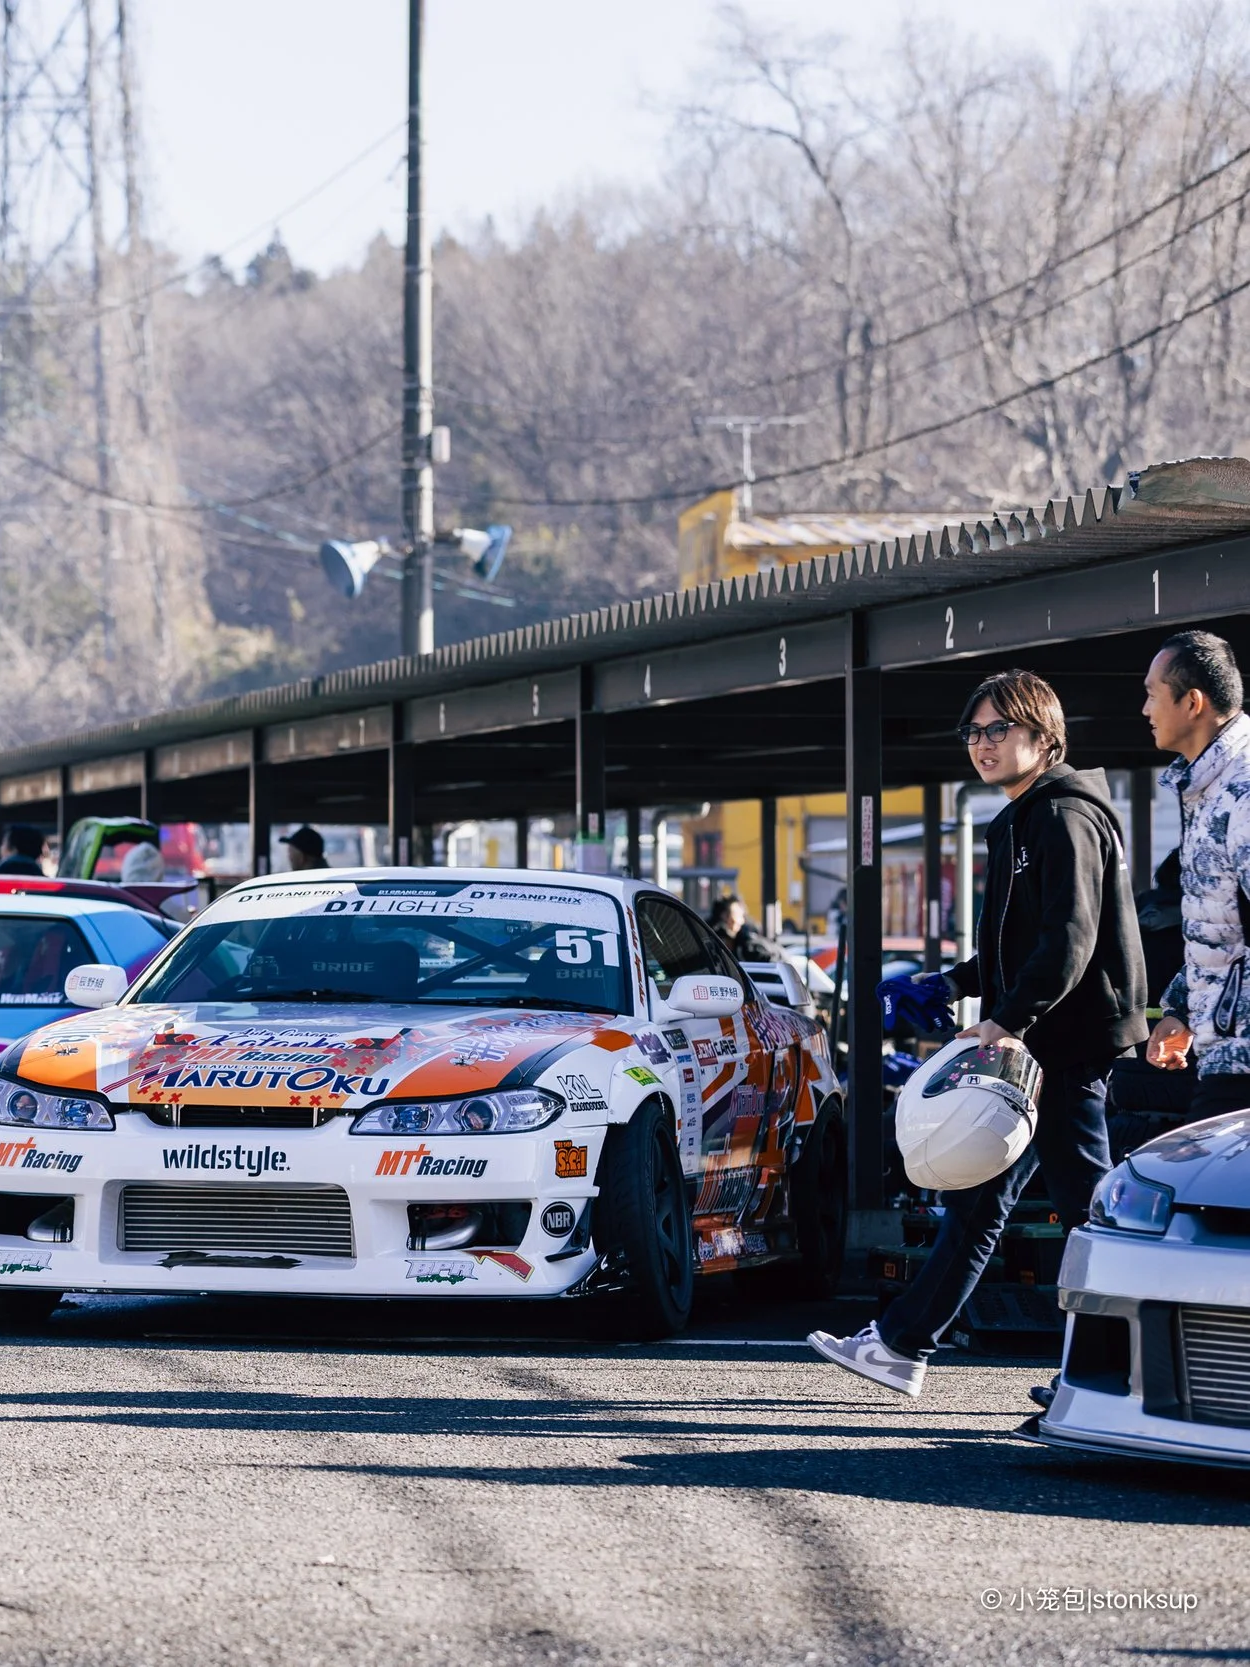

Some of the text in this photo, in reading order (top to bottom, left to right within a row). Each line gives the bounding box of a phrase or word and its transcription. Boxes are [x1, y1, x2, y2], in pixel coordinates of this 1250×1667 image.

[1152, 569, 1160, 615] 1
[945, 606, 954, 649] 2
[778, 637, 787, 677] 3
[643, 664, 651, 699] 4
[238, 889, 345, 903] D1 GRAND PRIX
[470, 891, 582, 904] D1 GRAND PRIX
[555, 929, 620, 968] 51
[312, 961, 375, 973] BRIDE
[21, 1149, 83, 1173] Racing
[417, 1155, 488, 1178] Racing
[546, 1212, 571, 1229] NBR
